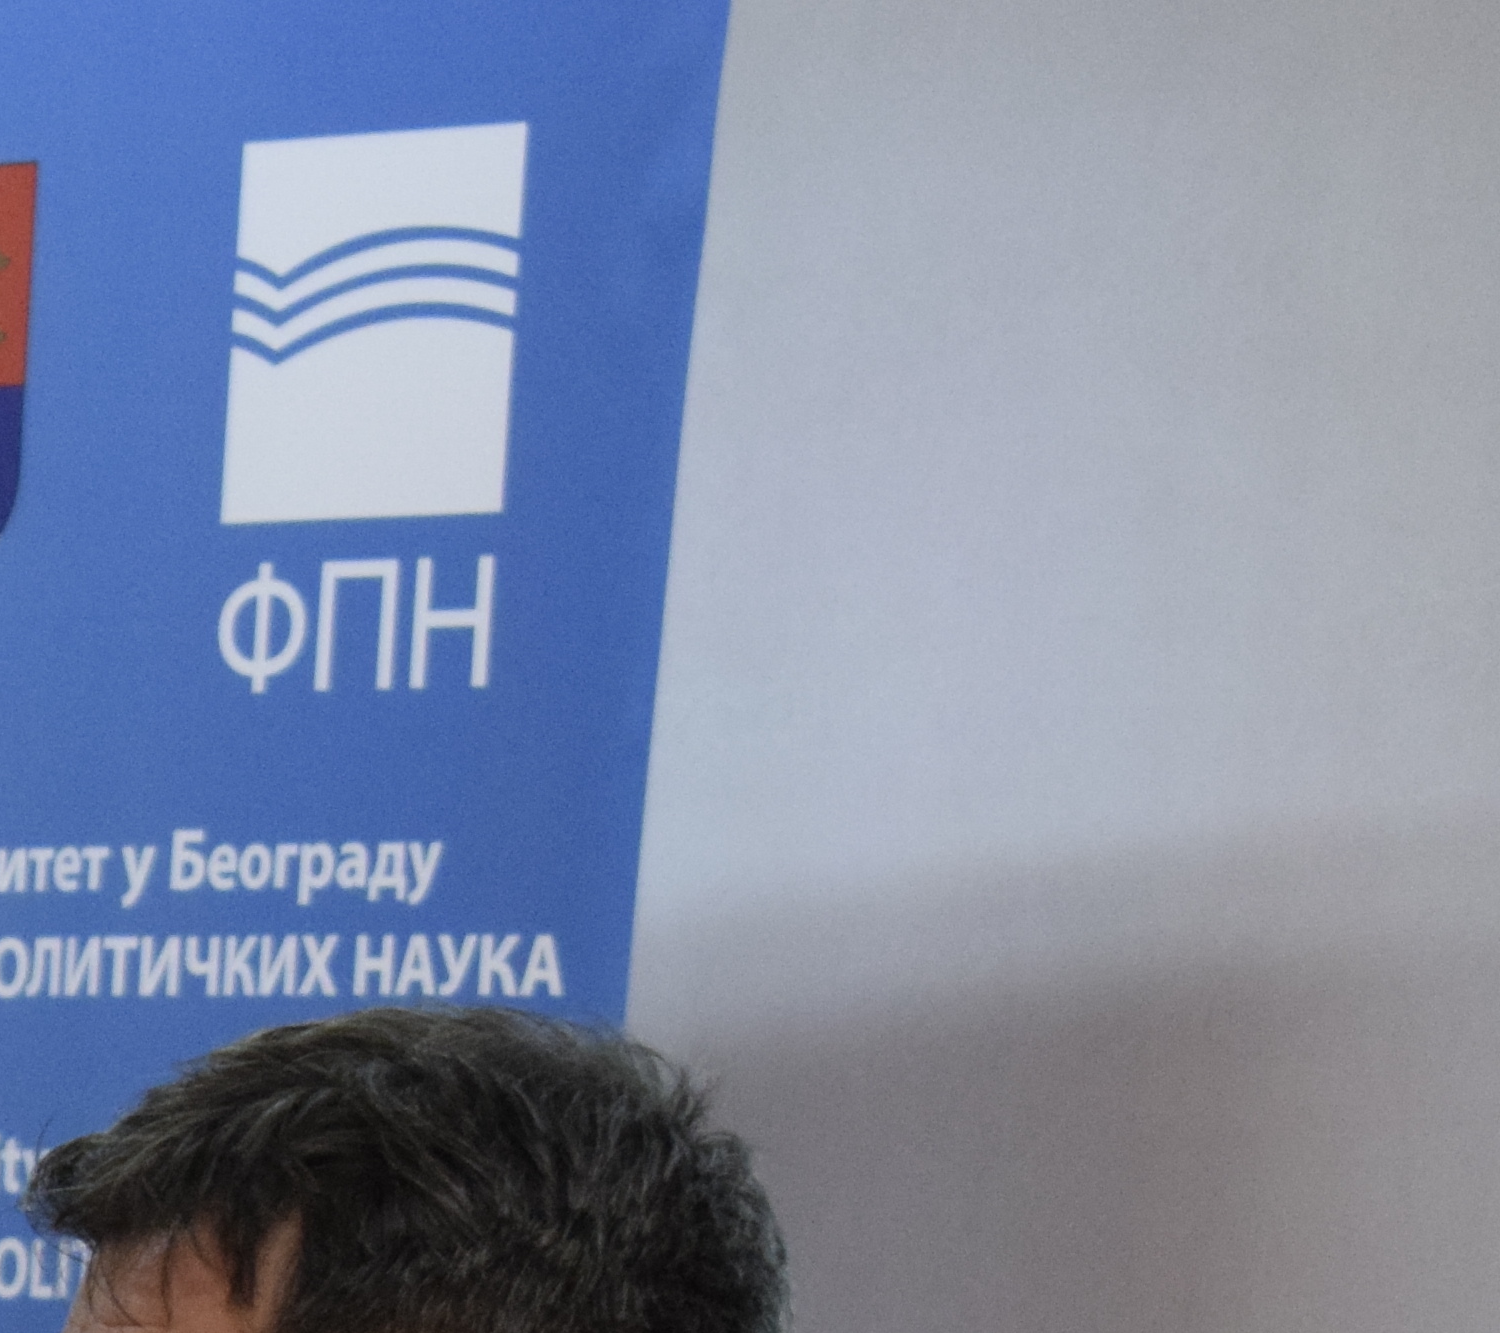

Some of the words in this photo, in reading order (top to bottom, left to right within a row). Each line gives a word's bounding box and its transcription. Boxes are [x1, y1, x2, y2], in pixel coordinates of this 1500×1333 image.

[217, 554, 496, 694] ФПН
[121, 844, 158, 907] у
[169, 828, 443, 904] Београду
[353, 933, 565, 997] НАУКА
